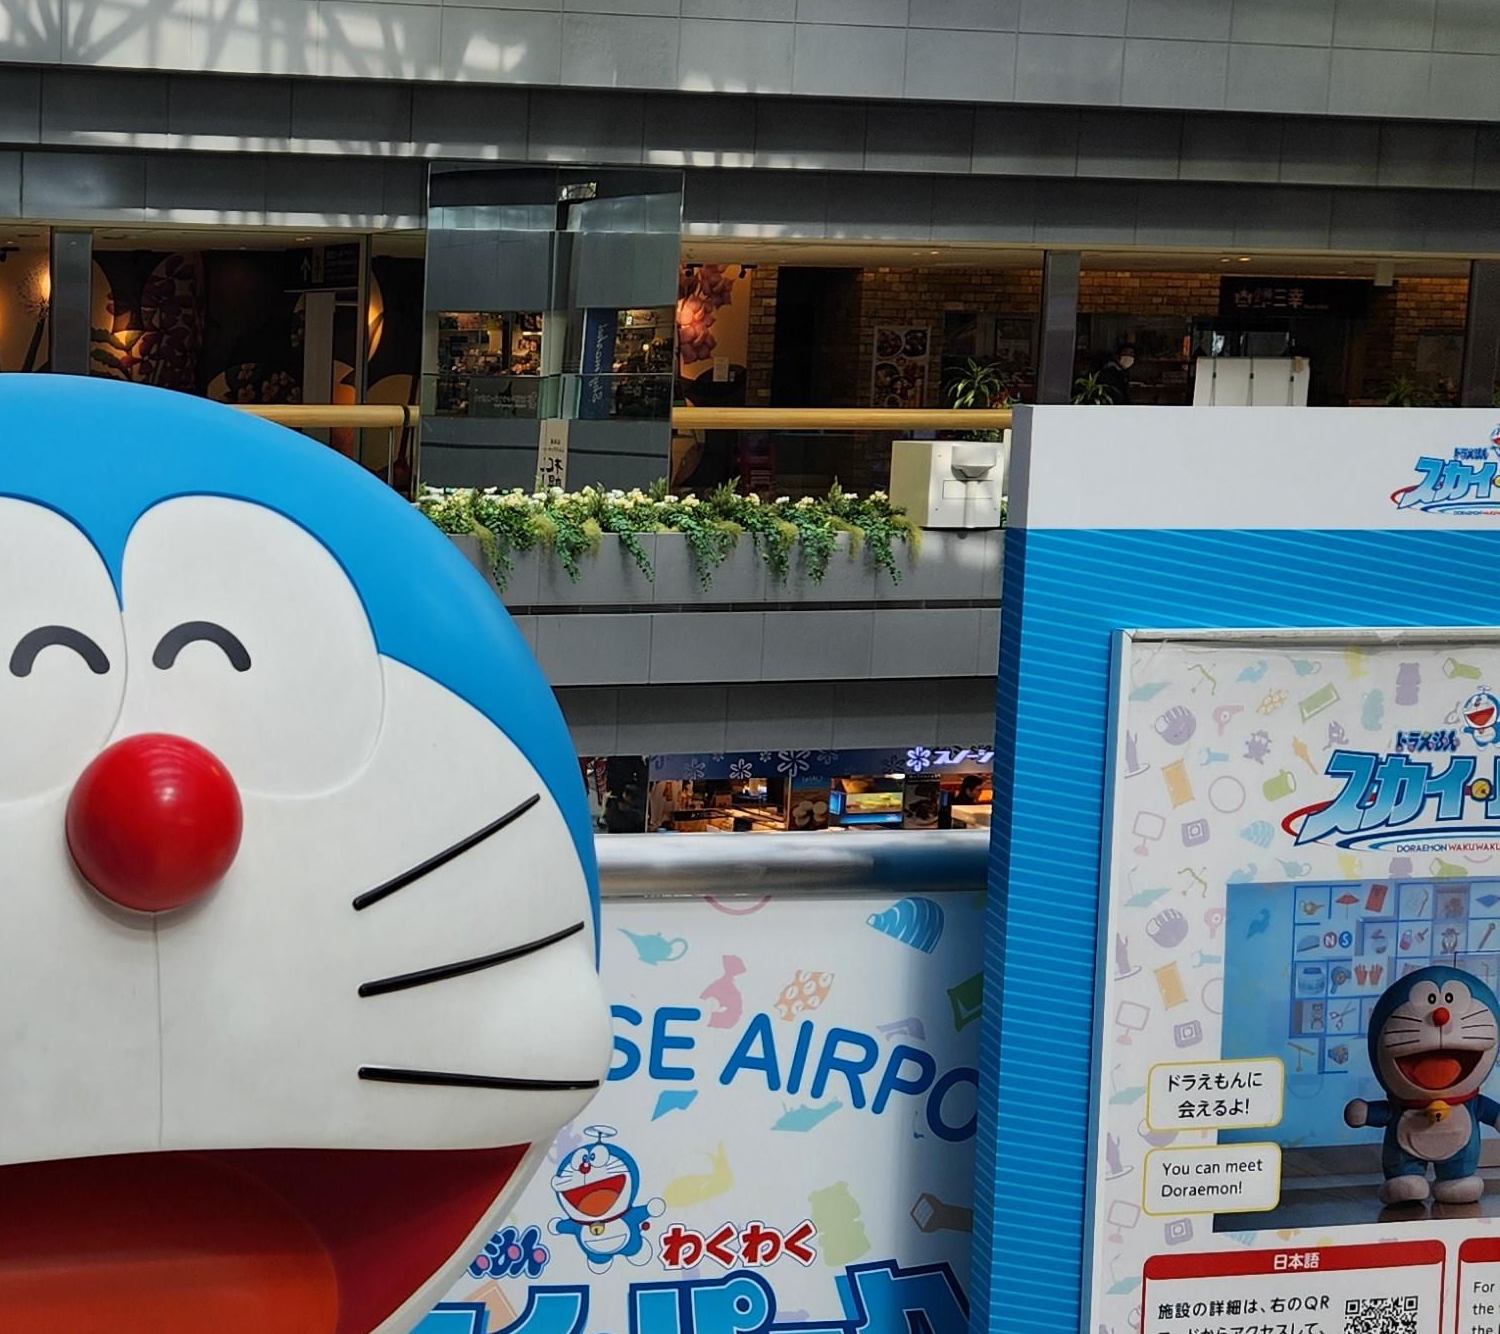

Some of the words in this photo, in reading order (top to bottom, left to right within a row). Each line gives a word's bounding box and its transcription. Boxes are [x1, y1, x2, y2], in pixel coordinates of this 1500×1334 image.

[1294, 750, 1500, 846] スカイ
[1396, 843, 1447, 853] DORAEMON
[1168, 1072, 1263, 1093] ドラえもんに
[1162, 1163, 1190, 1176] You
[1195, 1164, 1220, 1175] can
[1225, 1159, 1263, 1173] meet
[1161, 1182, 1242, 1198] Doraemon!
[660, 1220, 816, 1270] わくわく
[1273, 1252, 1320, 1270] 日本語
[1473, 1281, 1495, 1294] For
[1158, 1295, 1331, 1321] 施設の詳細は、右のQR
[1472, 1302, 1495, 1315] the
